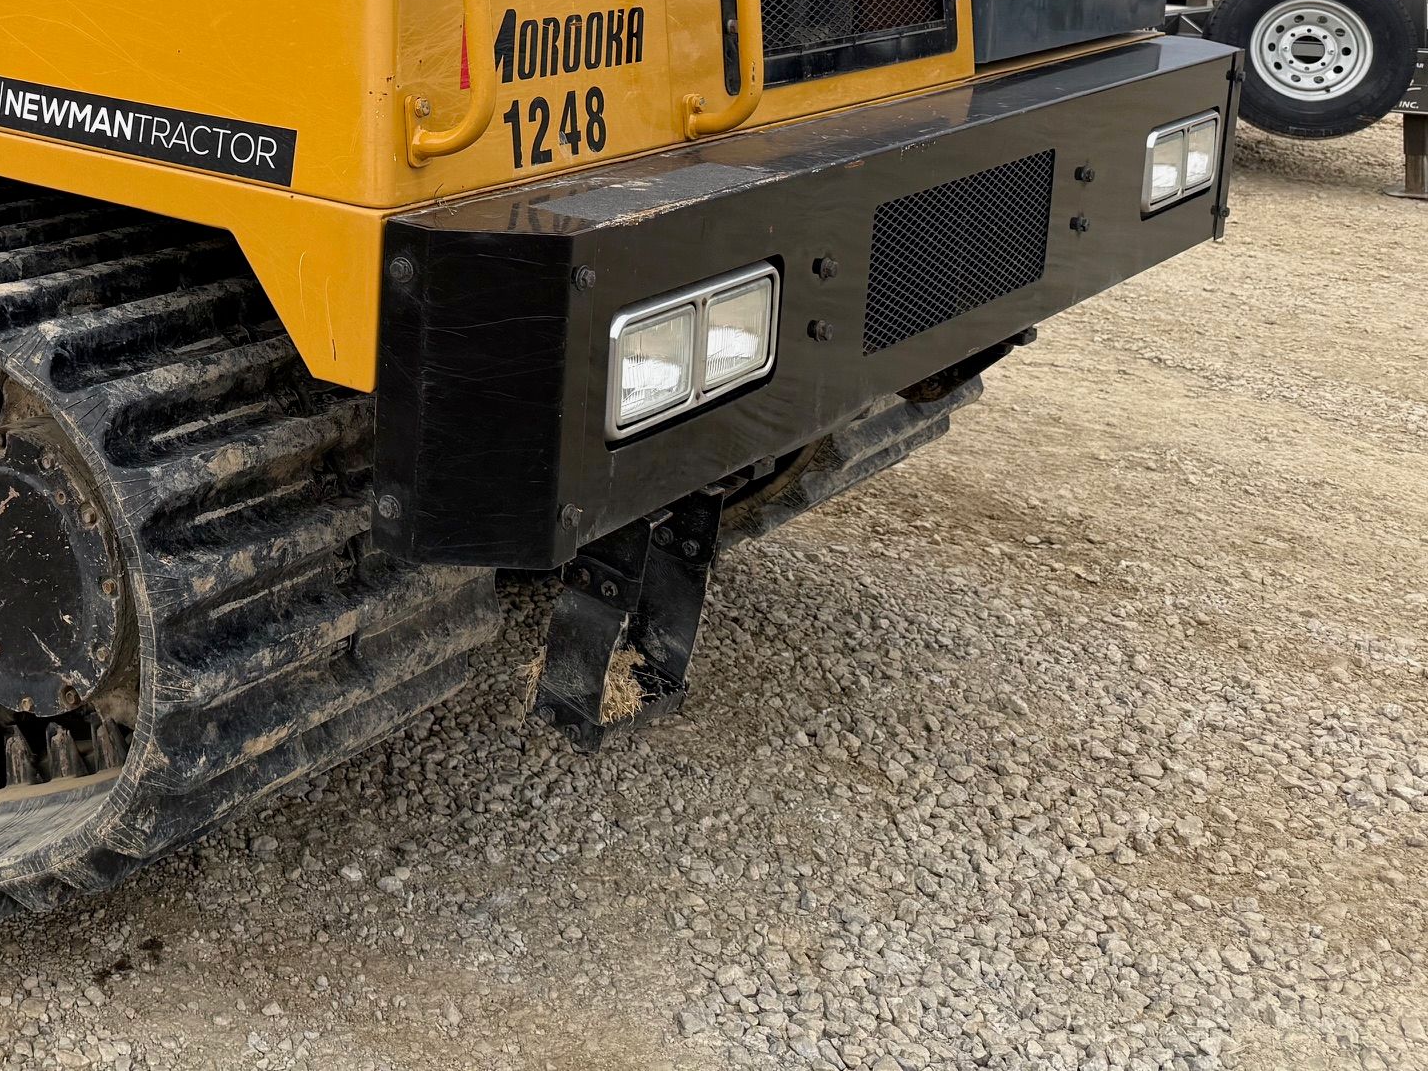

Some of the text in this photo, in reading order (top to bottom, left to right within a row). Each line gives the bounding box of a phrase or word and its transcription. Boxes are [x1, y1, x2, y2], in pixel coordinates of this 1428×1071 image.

[460, 6, 644, 89] MOROOKA
[4, 88, 278, 169] NEWMANTRACTOR
[503, 86, 607, 169] 1248
[1398, 100, 1419, 109] INC.
